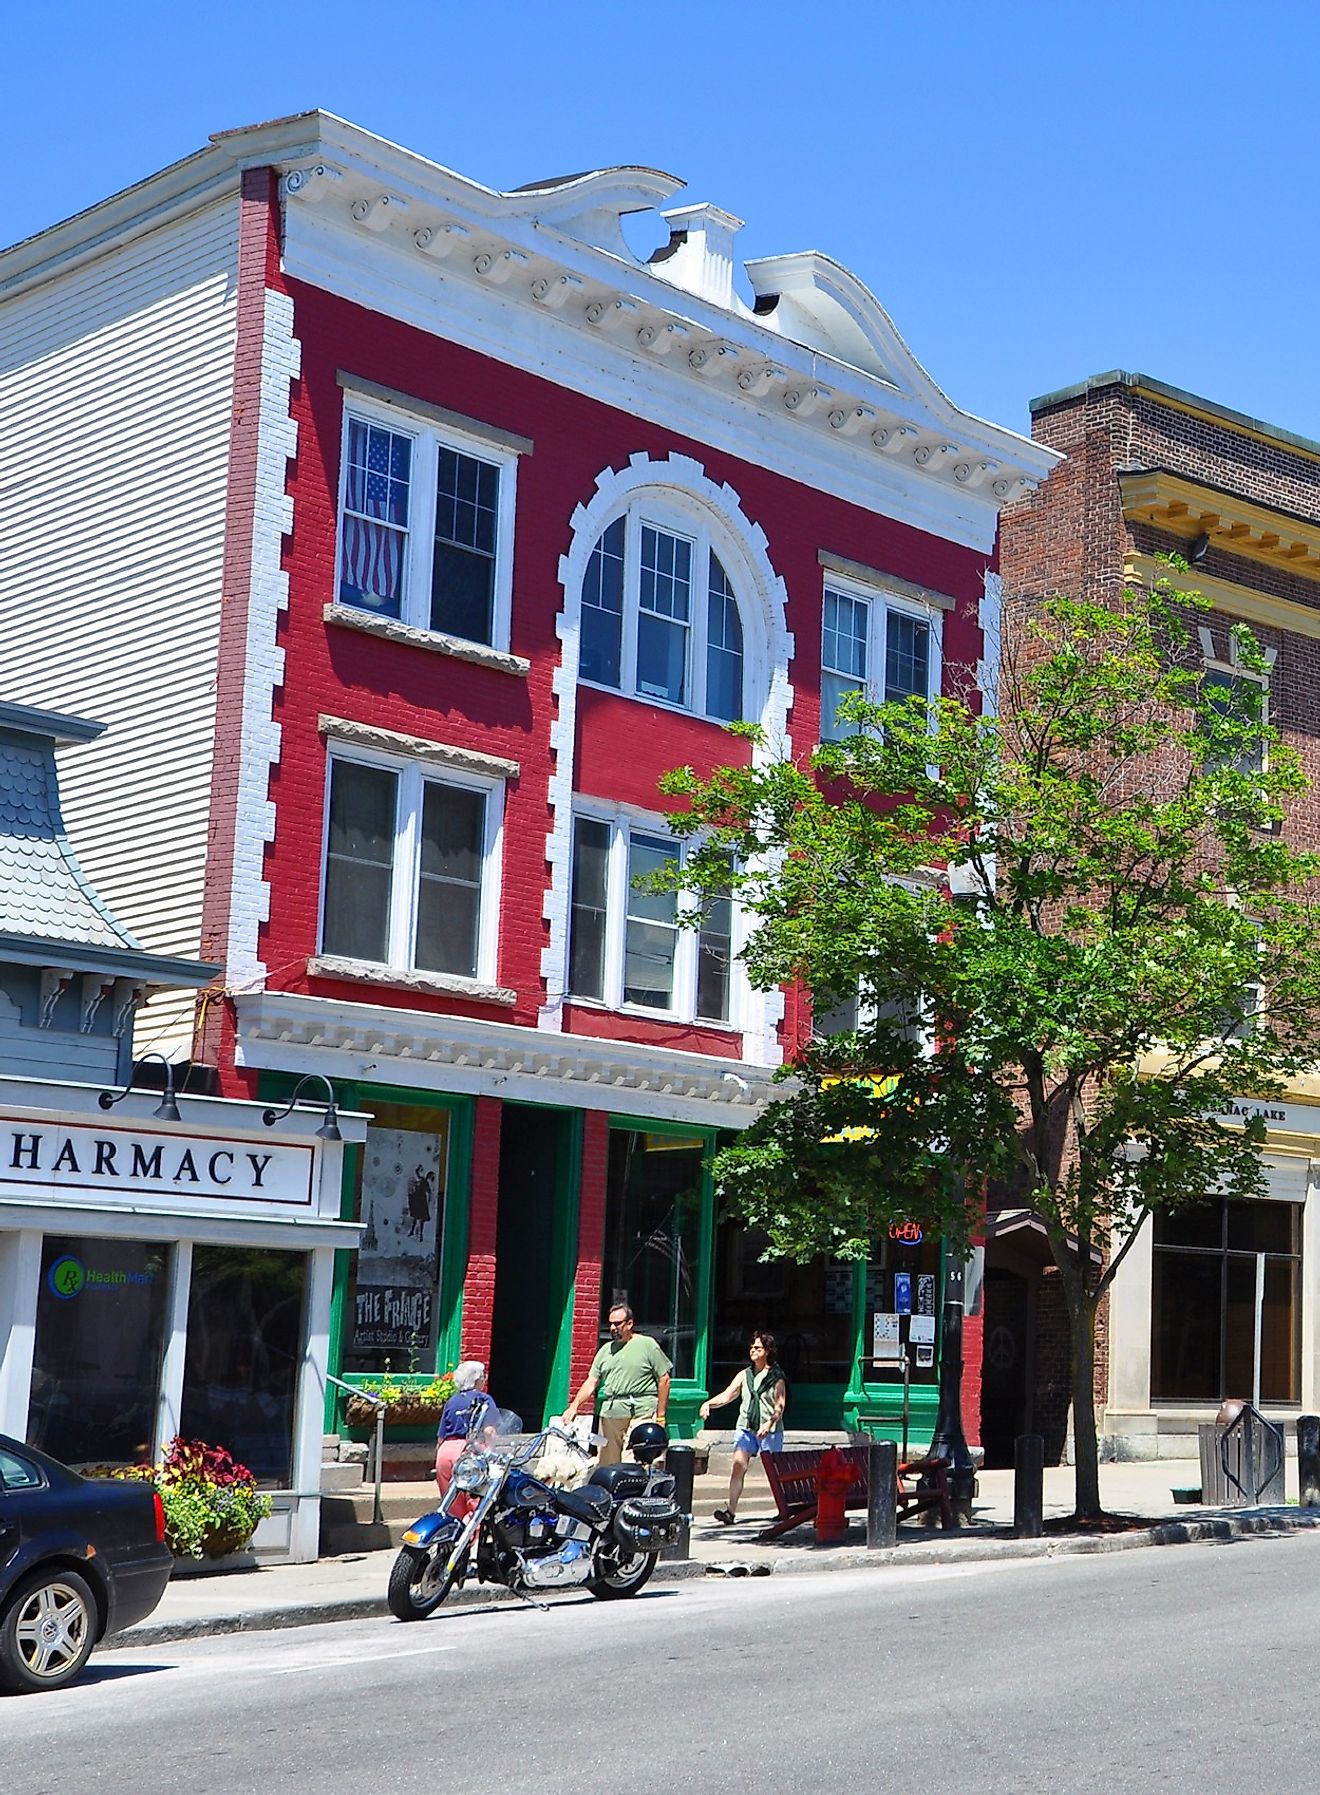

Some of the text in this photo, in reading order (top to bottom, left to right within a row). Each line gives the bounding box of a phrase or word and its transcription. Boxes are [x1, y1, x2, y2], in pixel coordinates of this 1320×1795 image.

[1255, 1108, 1286, 1121] LAKE
[9, 1133, 272, 1187] HARMACY
[356, 1289, 430, 1331] THE FRINGE
